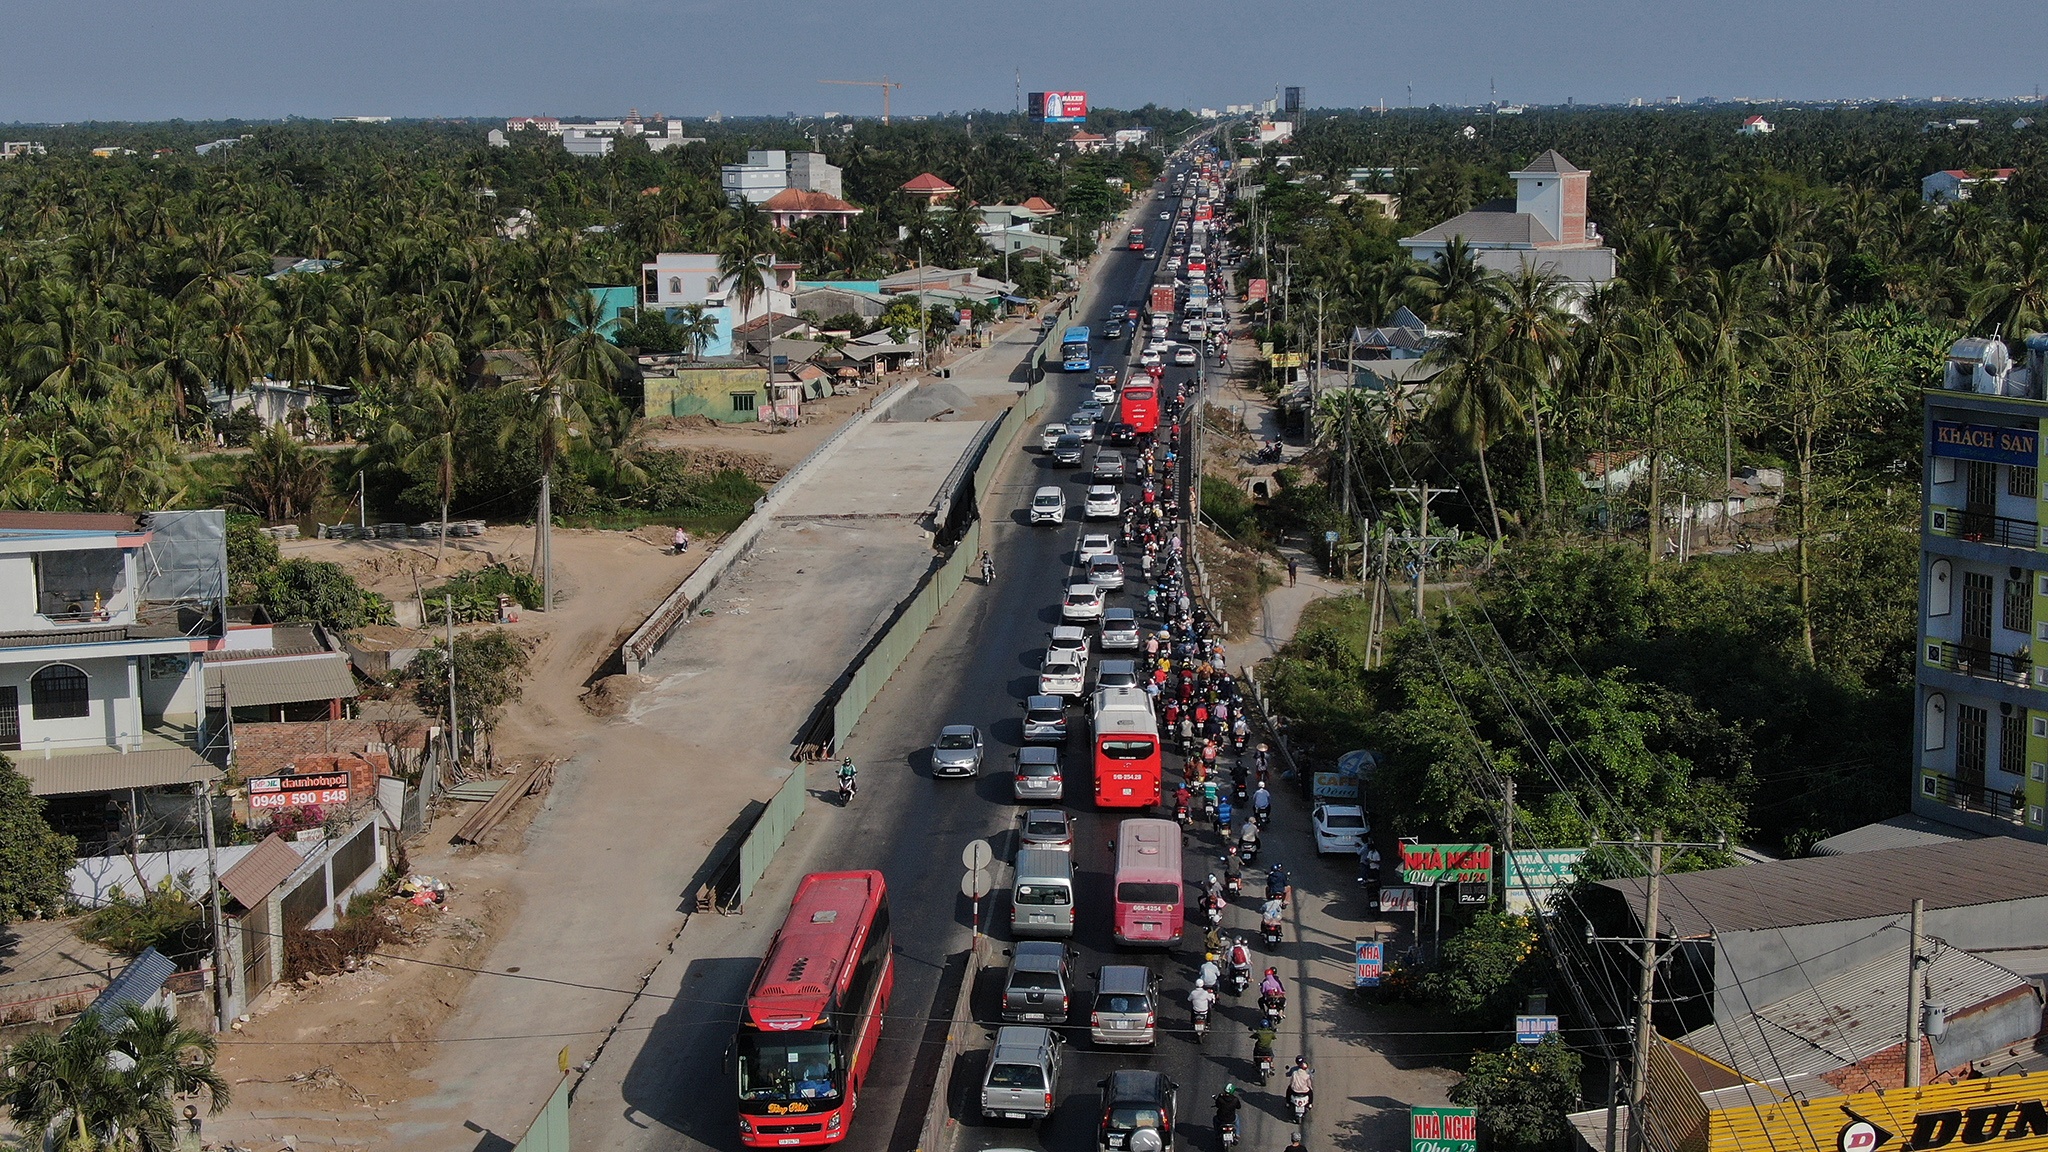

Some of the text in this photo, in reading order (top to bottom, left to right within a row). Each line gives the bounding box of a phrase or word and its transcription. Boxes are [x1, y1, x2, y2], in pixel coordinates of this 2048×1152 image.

[1938, 425, 2034, 455] KHÁCH SẠN
[252, 790, 347, 807] 0949 590 548
[1404, 846, 1491, 870] NHÀ NGHỈ
[1414, 1109, 1476, 1141] NHÀ NGHỈ
